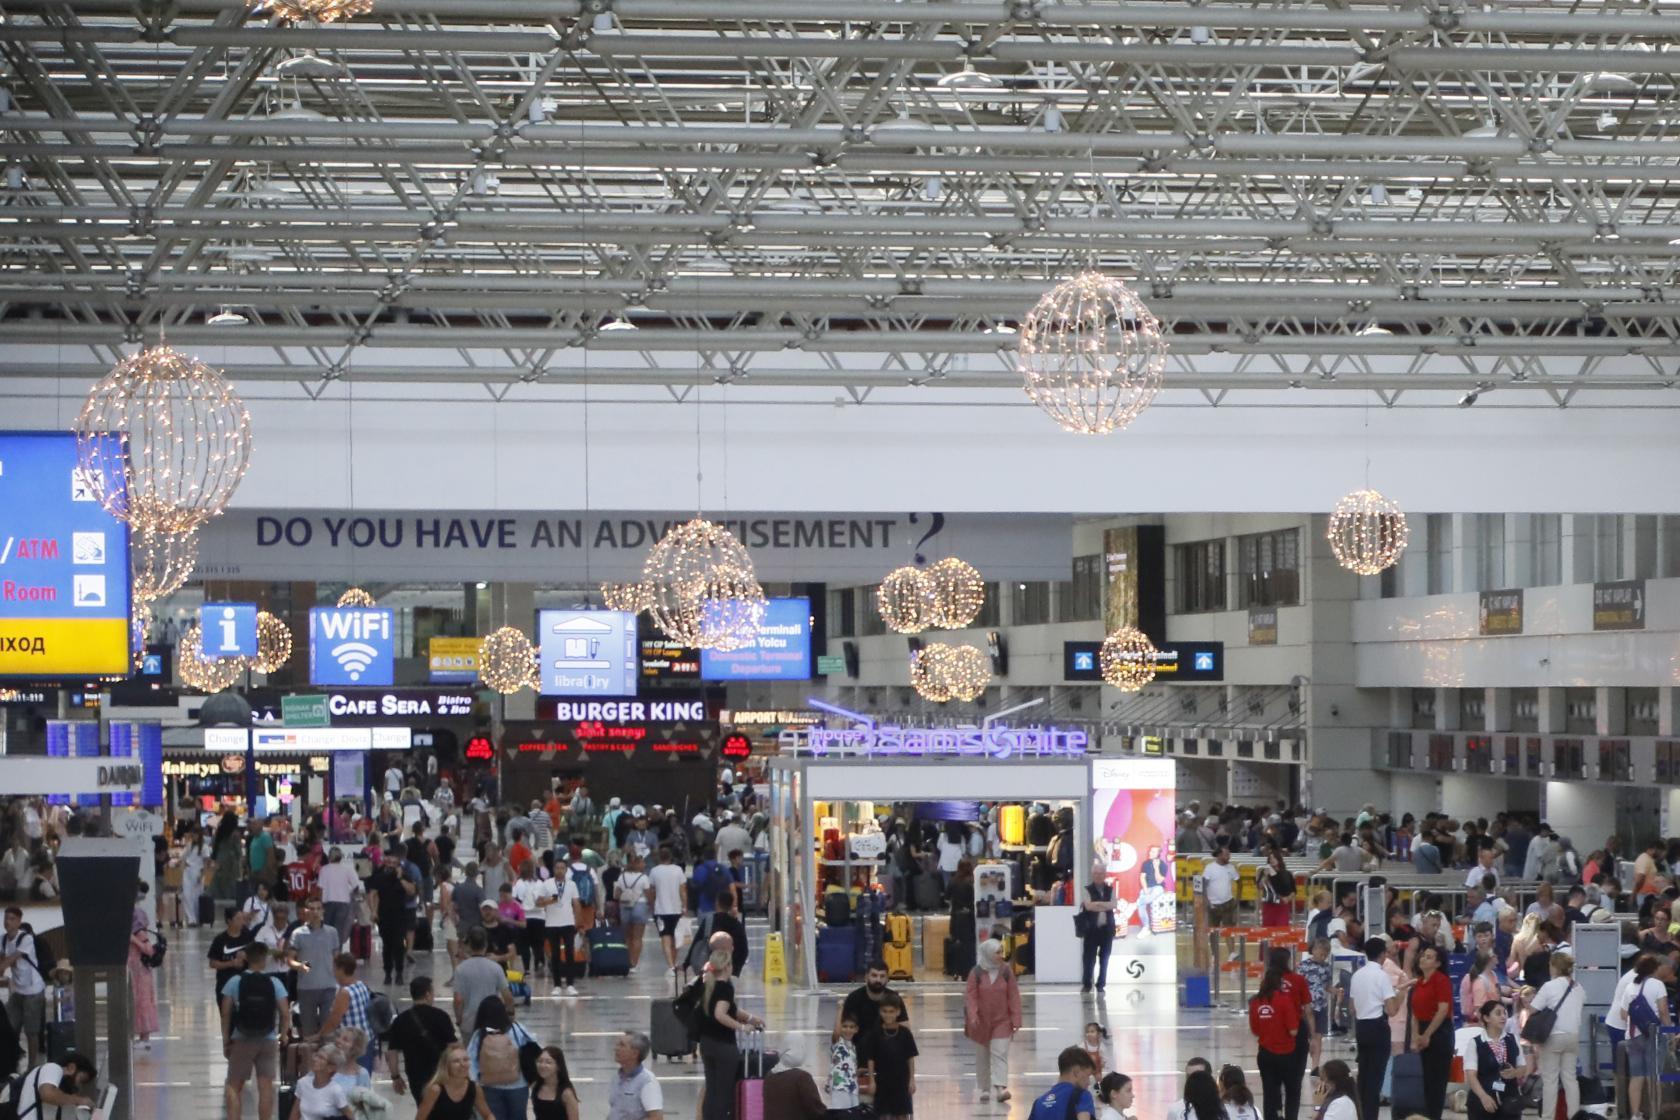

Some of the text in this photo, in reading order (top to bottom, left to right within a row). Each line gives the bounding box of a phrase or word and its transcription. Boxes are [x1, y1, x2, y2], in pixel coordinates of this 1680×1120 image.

[256, 516, 313, 547] DO
[322, 517, 403, 548] YOU
[415, 518, 517, 549] HAVE
[530, 519, 583, 549] AN
[593, 518, 896, 549] ADVTISEMENT
[17, 538, 60, 560] ATM
[3, 580, 57, 601] Room
[320, 612, 389, 640] WiFi
[757, 637, 787, 648] Yolcu
[329, 694, 431, 716] CAFE SERA
[437, 695, 472, 706] Bistro
[437, 705, 472, 715] & Bar
[557, 702, 704, 721] BURGER KING
[734, 711, 777, 724] AIRPORT
[208, 733, 246, 745] Change
